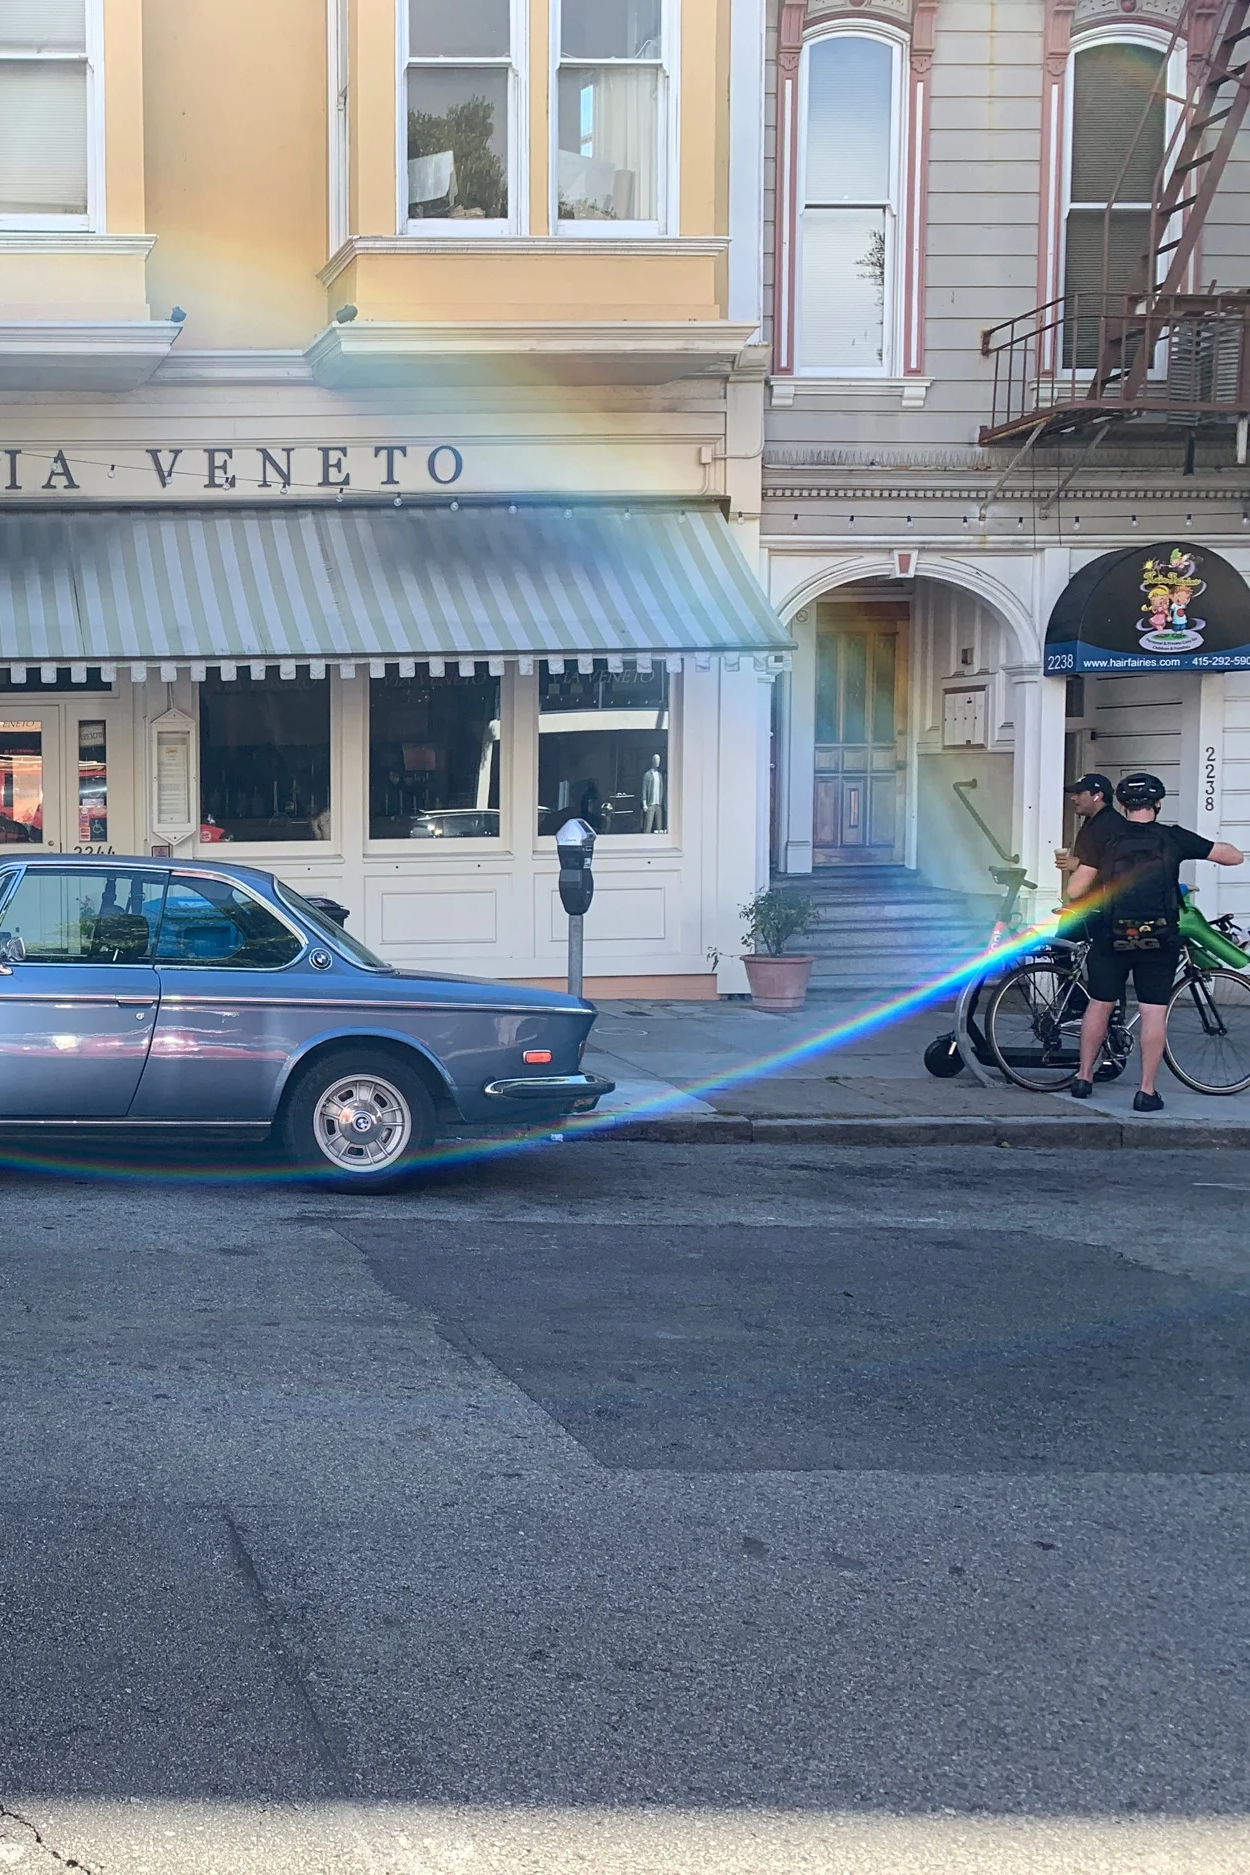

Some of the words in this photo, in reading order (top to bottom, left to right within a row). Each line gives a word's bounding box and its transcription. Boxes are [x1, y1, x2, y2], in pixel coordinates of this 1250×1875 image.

[146, 445, 464, 489] VENETO
[1048, 654, 1073, 670] 2238
[1083, 656, 1180, 668] www.hairfairies.com
[1205, 746, 1216, 812] 2238
